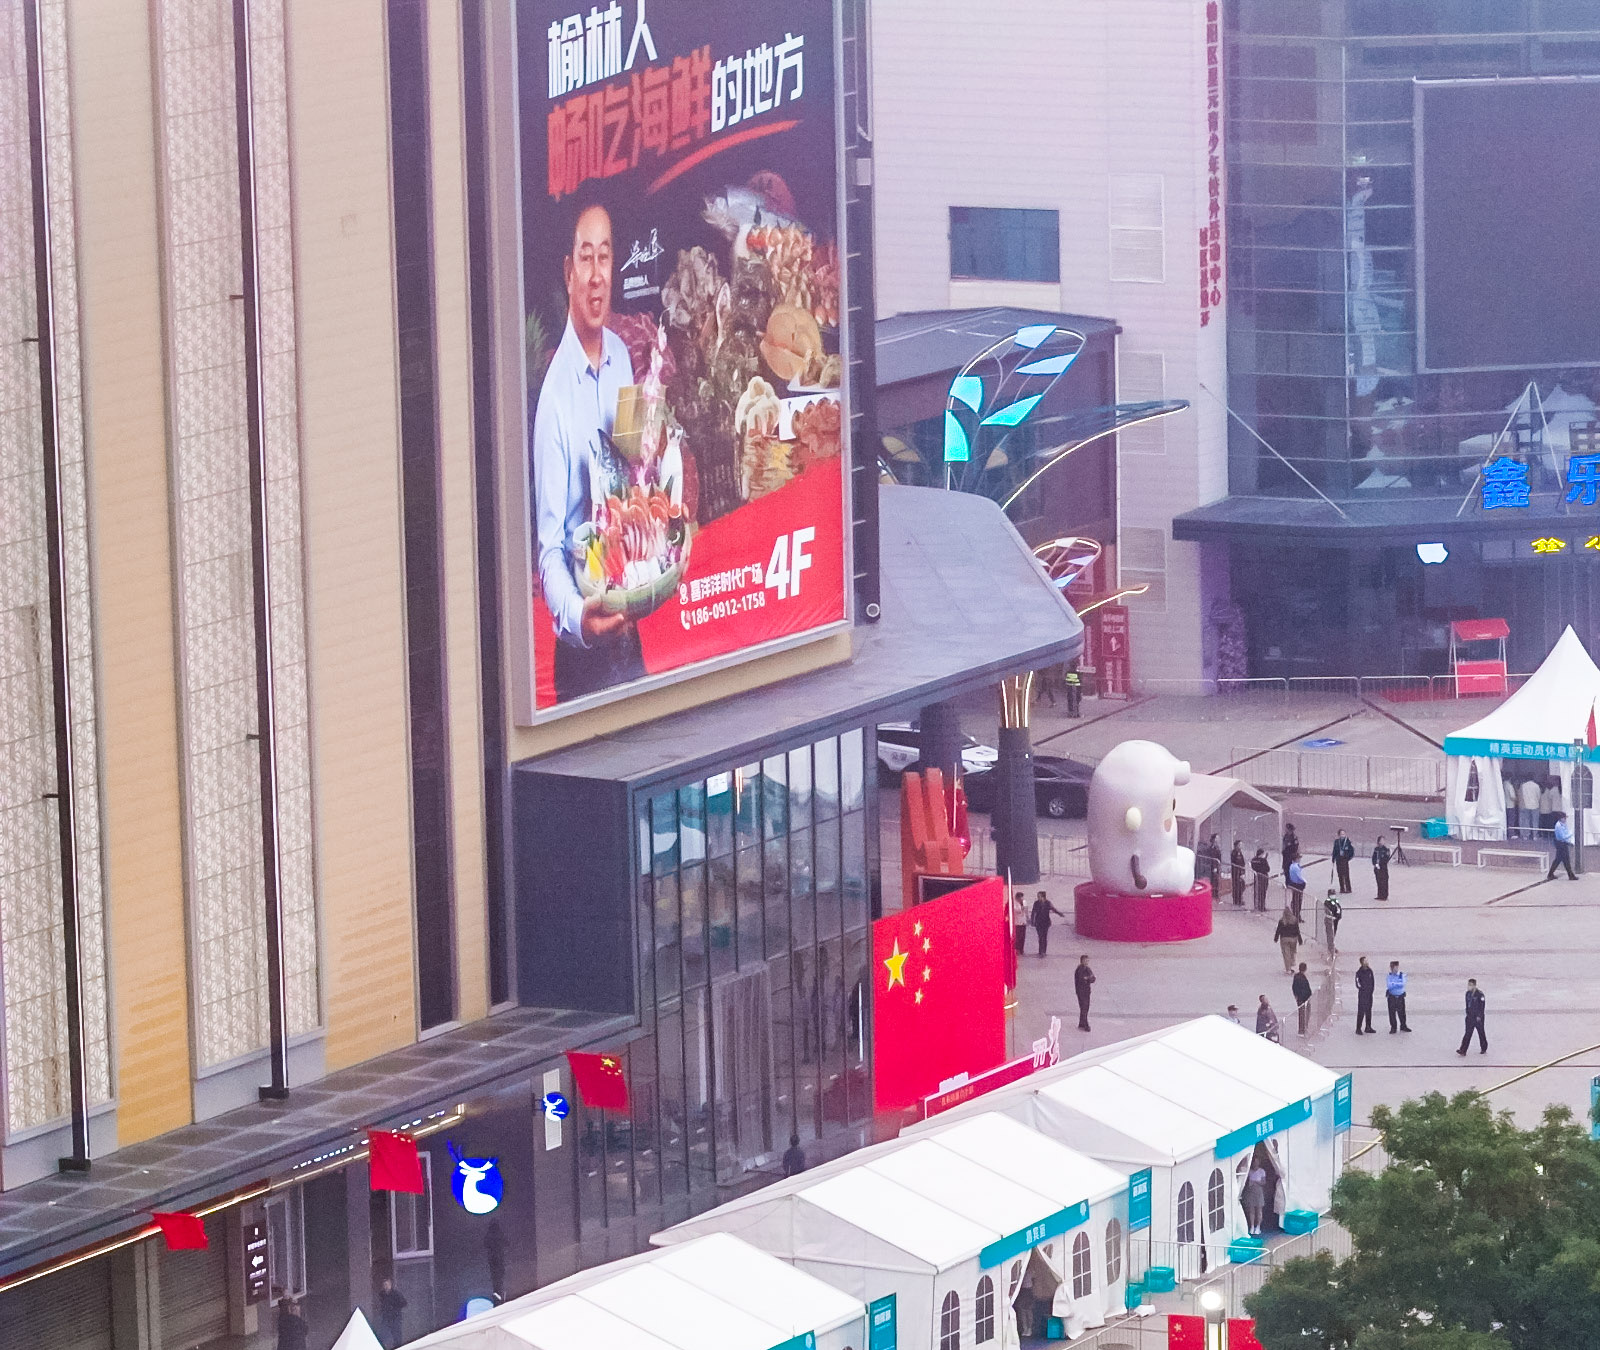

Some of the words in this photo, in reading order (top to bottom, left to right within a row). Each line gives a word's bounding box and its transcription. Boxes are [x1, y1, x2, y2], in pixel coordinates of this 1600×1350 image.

[548, 0, 658, 99] 榆林人
[547, 32, 804, 201] 畅吃海鲜的地方
[690, 562, 763, 602] 喜洋洋时代广场
[764, 526, 816, 600] 4F
[691, 591, 766, 627] 186-0912-1758
